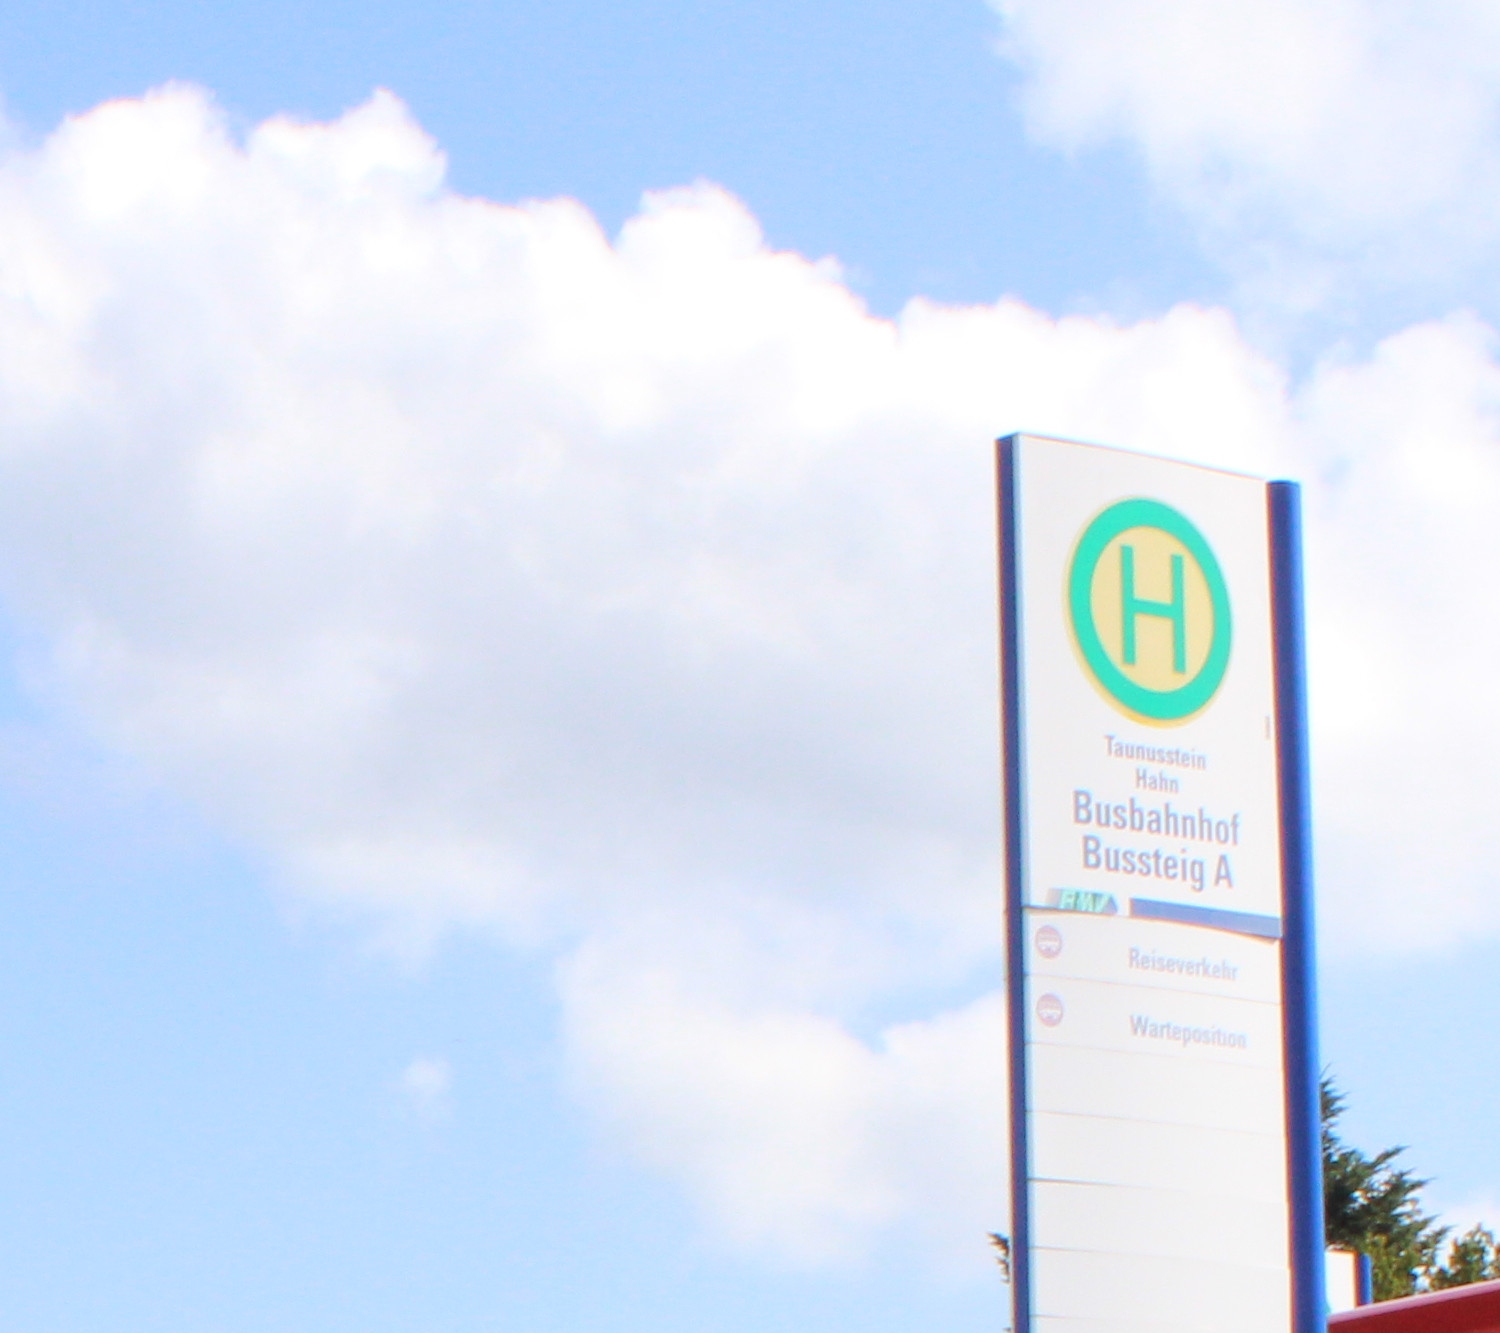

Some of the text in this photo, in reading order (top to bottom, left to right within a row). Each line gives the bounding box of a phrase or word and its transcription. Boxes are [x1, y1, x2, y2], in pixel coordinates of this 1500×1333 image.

[1119, 543, 1187, 675] H
[1104, 734, 1207, 770] Taunusstein
[1135, 767, 1180, 794] Hahn
[1072, 788, 1241, 847] Busbahnhof
[1081, 834, 1234, 892] Bussteig A
[1128, 947, 1238, 982] Reiseverkehr
[1130, 1014, 1248, 1049] Warteposition
